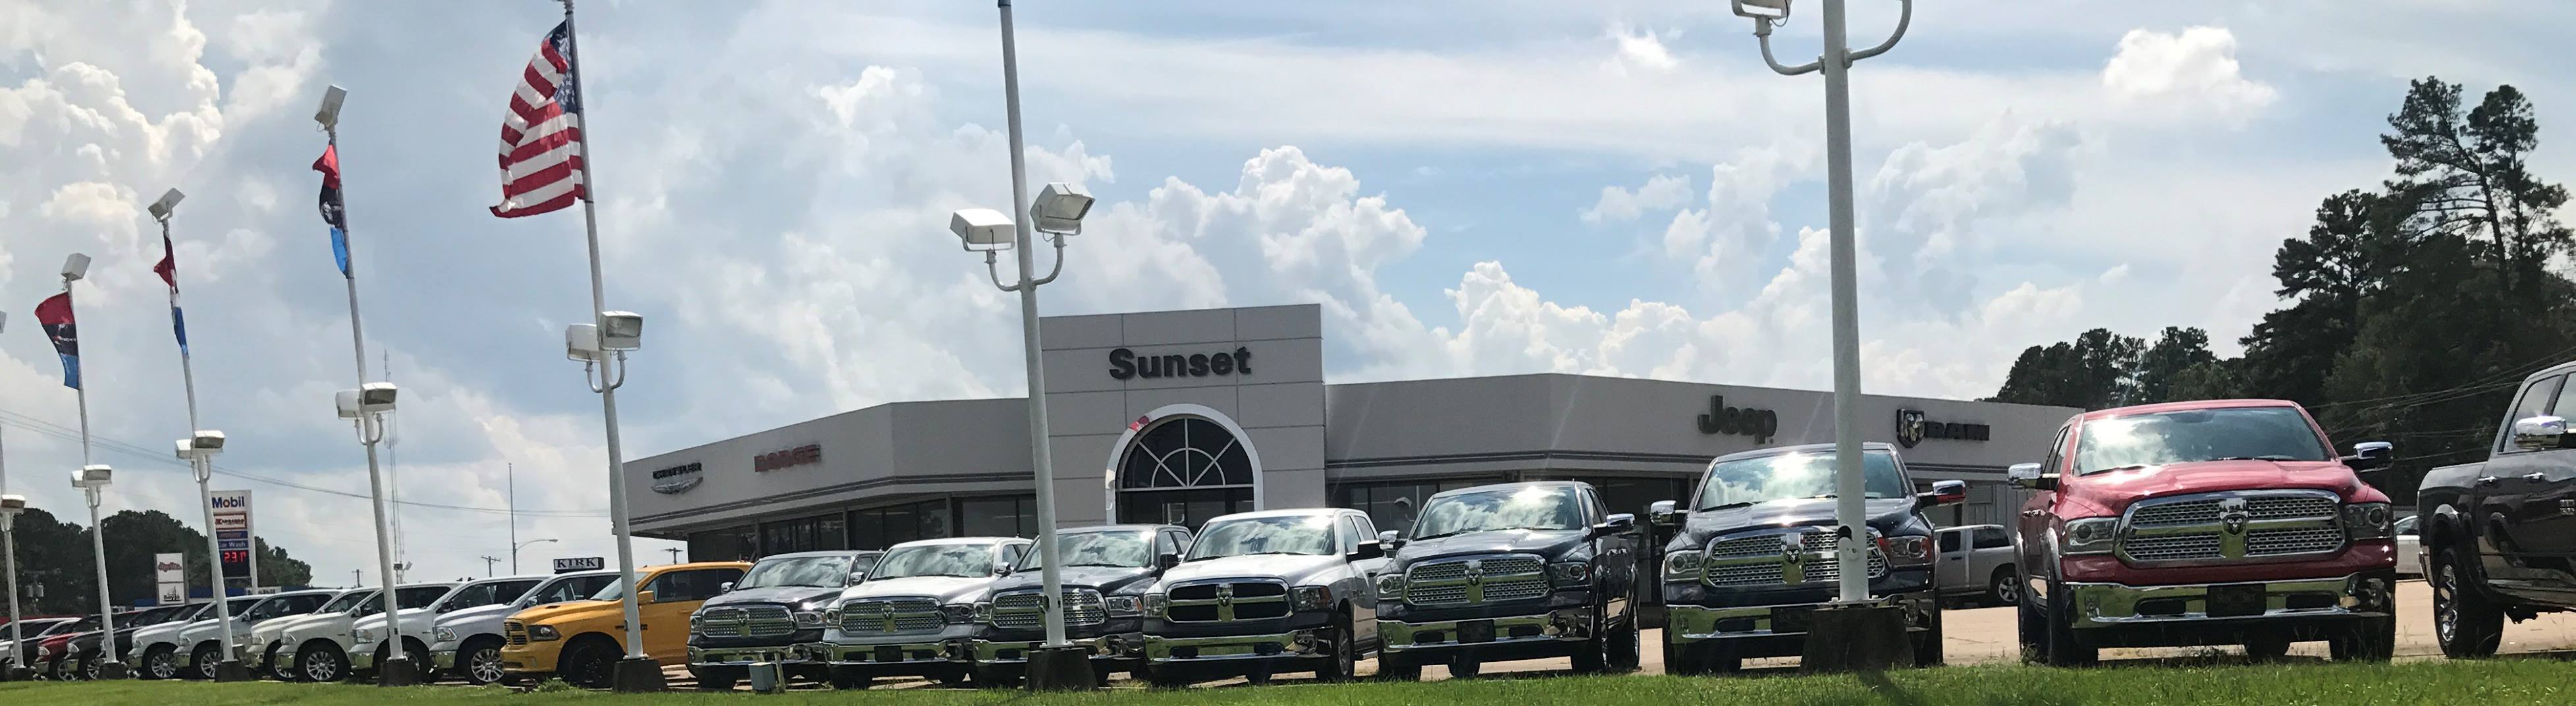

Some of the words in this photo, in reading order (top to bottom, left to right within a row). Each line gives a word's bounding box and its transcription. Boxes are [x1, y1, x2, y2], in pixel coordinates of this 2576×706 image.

[1109, 346, 1251, 380] Sunset
[1698, 395, 1777, 445] Jeep
[1924, 421, 1990, 441] RAM
[754, 444, 820, 472] DODGE
[211, 496, 245, 508] Mobil
[557, 558, 596, 568] KIRK
